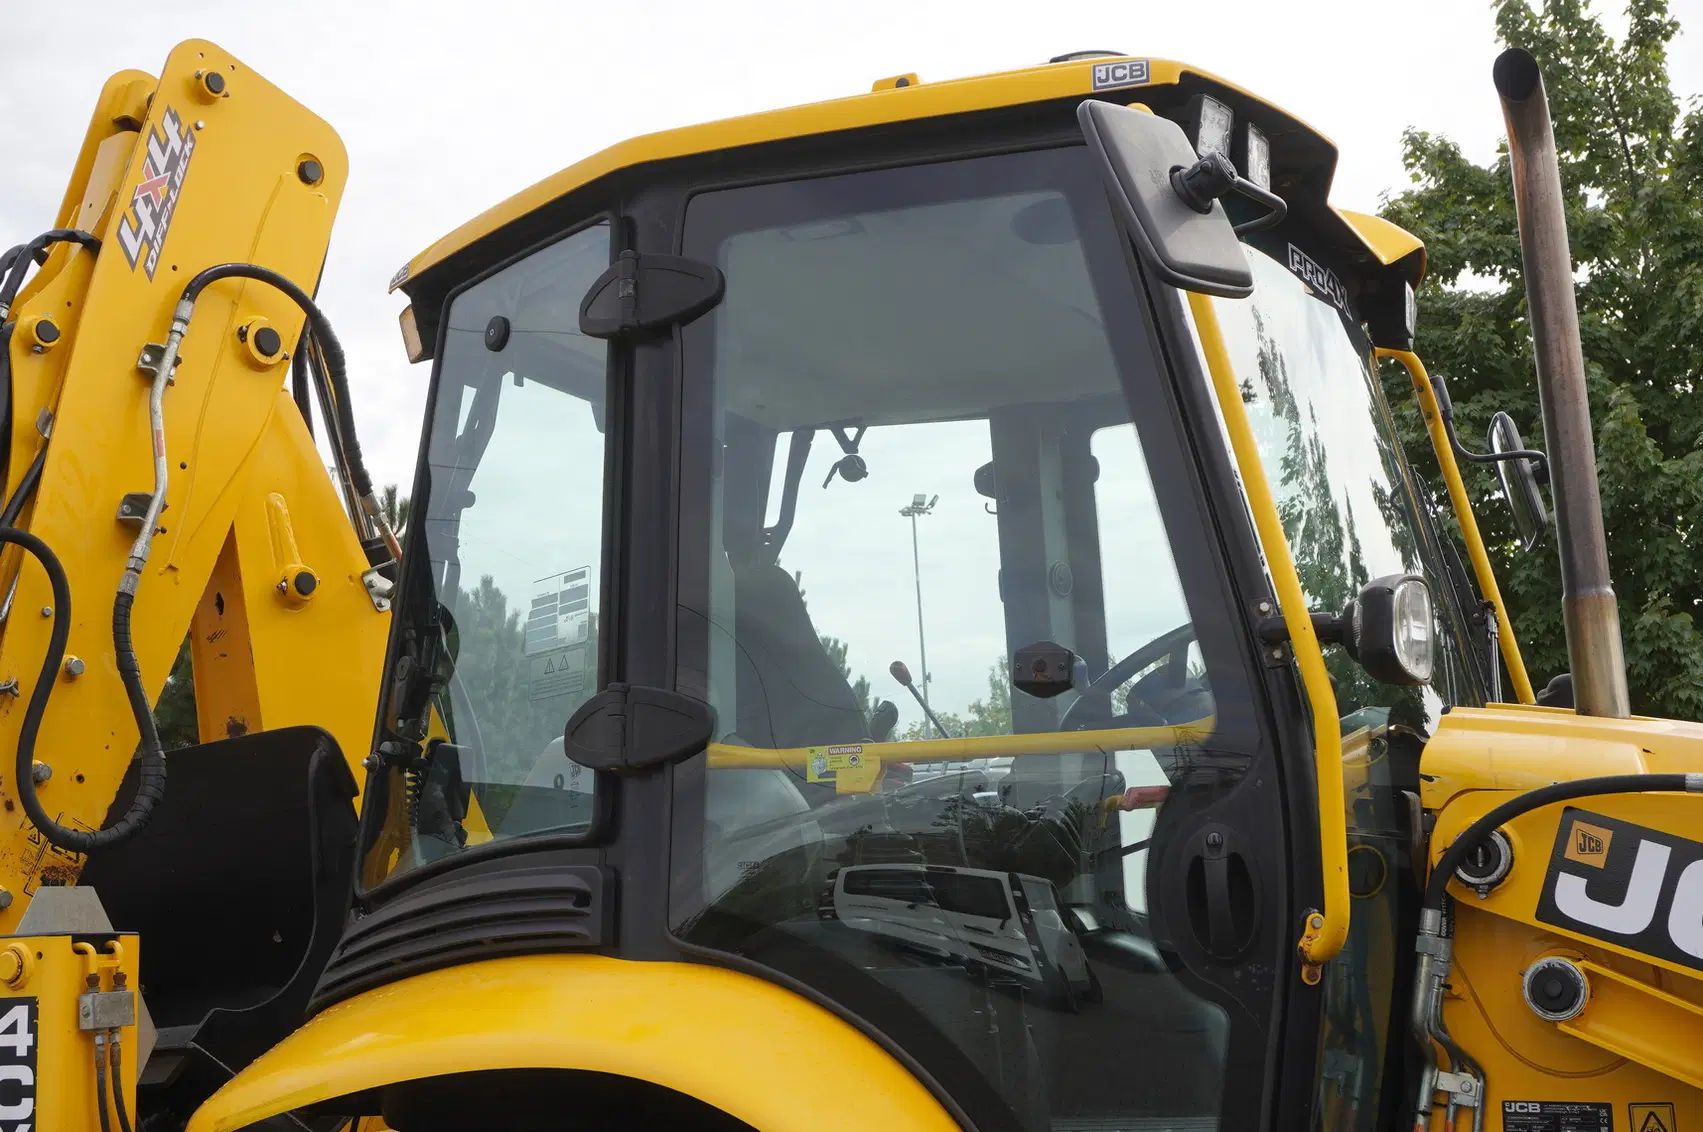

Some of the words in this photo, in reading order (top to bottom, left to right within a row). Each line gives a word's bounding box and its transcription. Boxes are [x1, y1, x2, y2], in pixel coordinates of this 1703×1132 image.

[1096, 63, 1145, 84] JCB
[829, 746, 862, 755] WARNING
[1578, 832, 1602, 853] JCB
[0, 1005, 34, 1132] 4C
[1504, 1102, 1541, 1113] JCB
